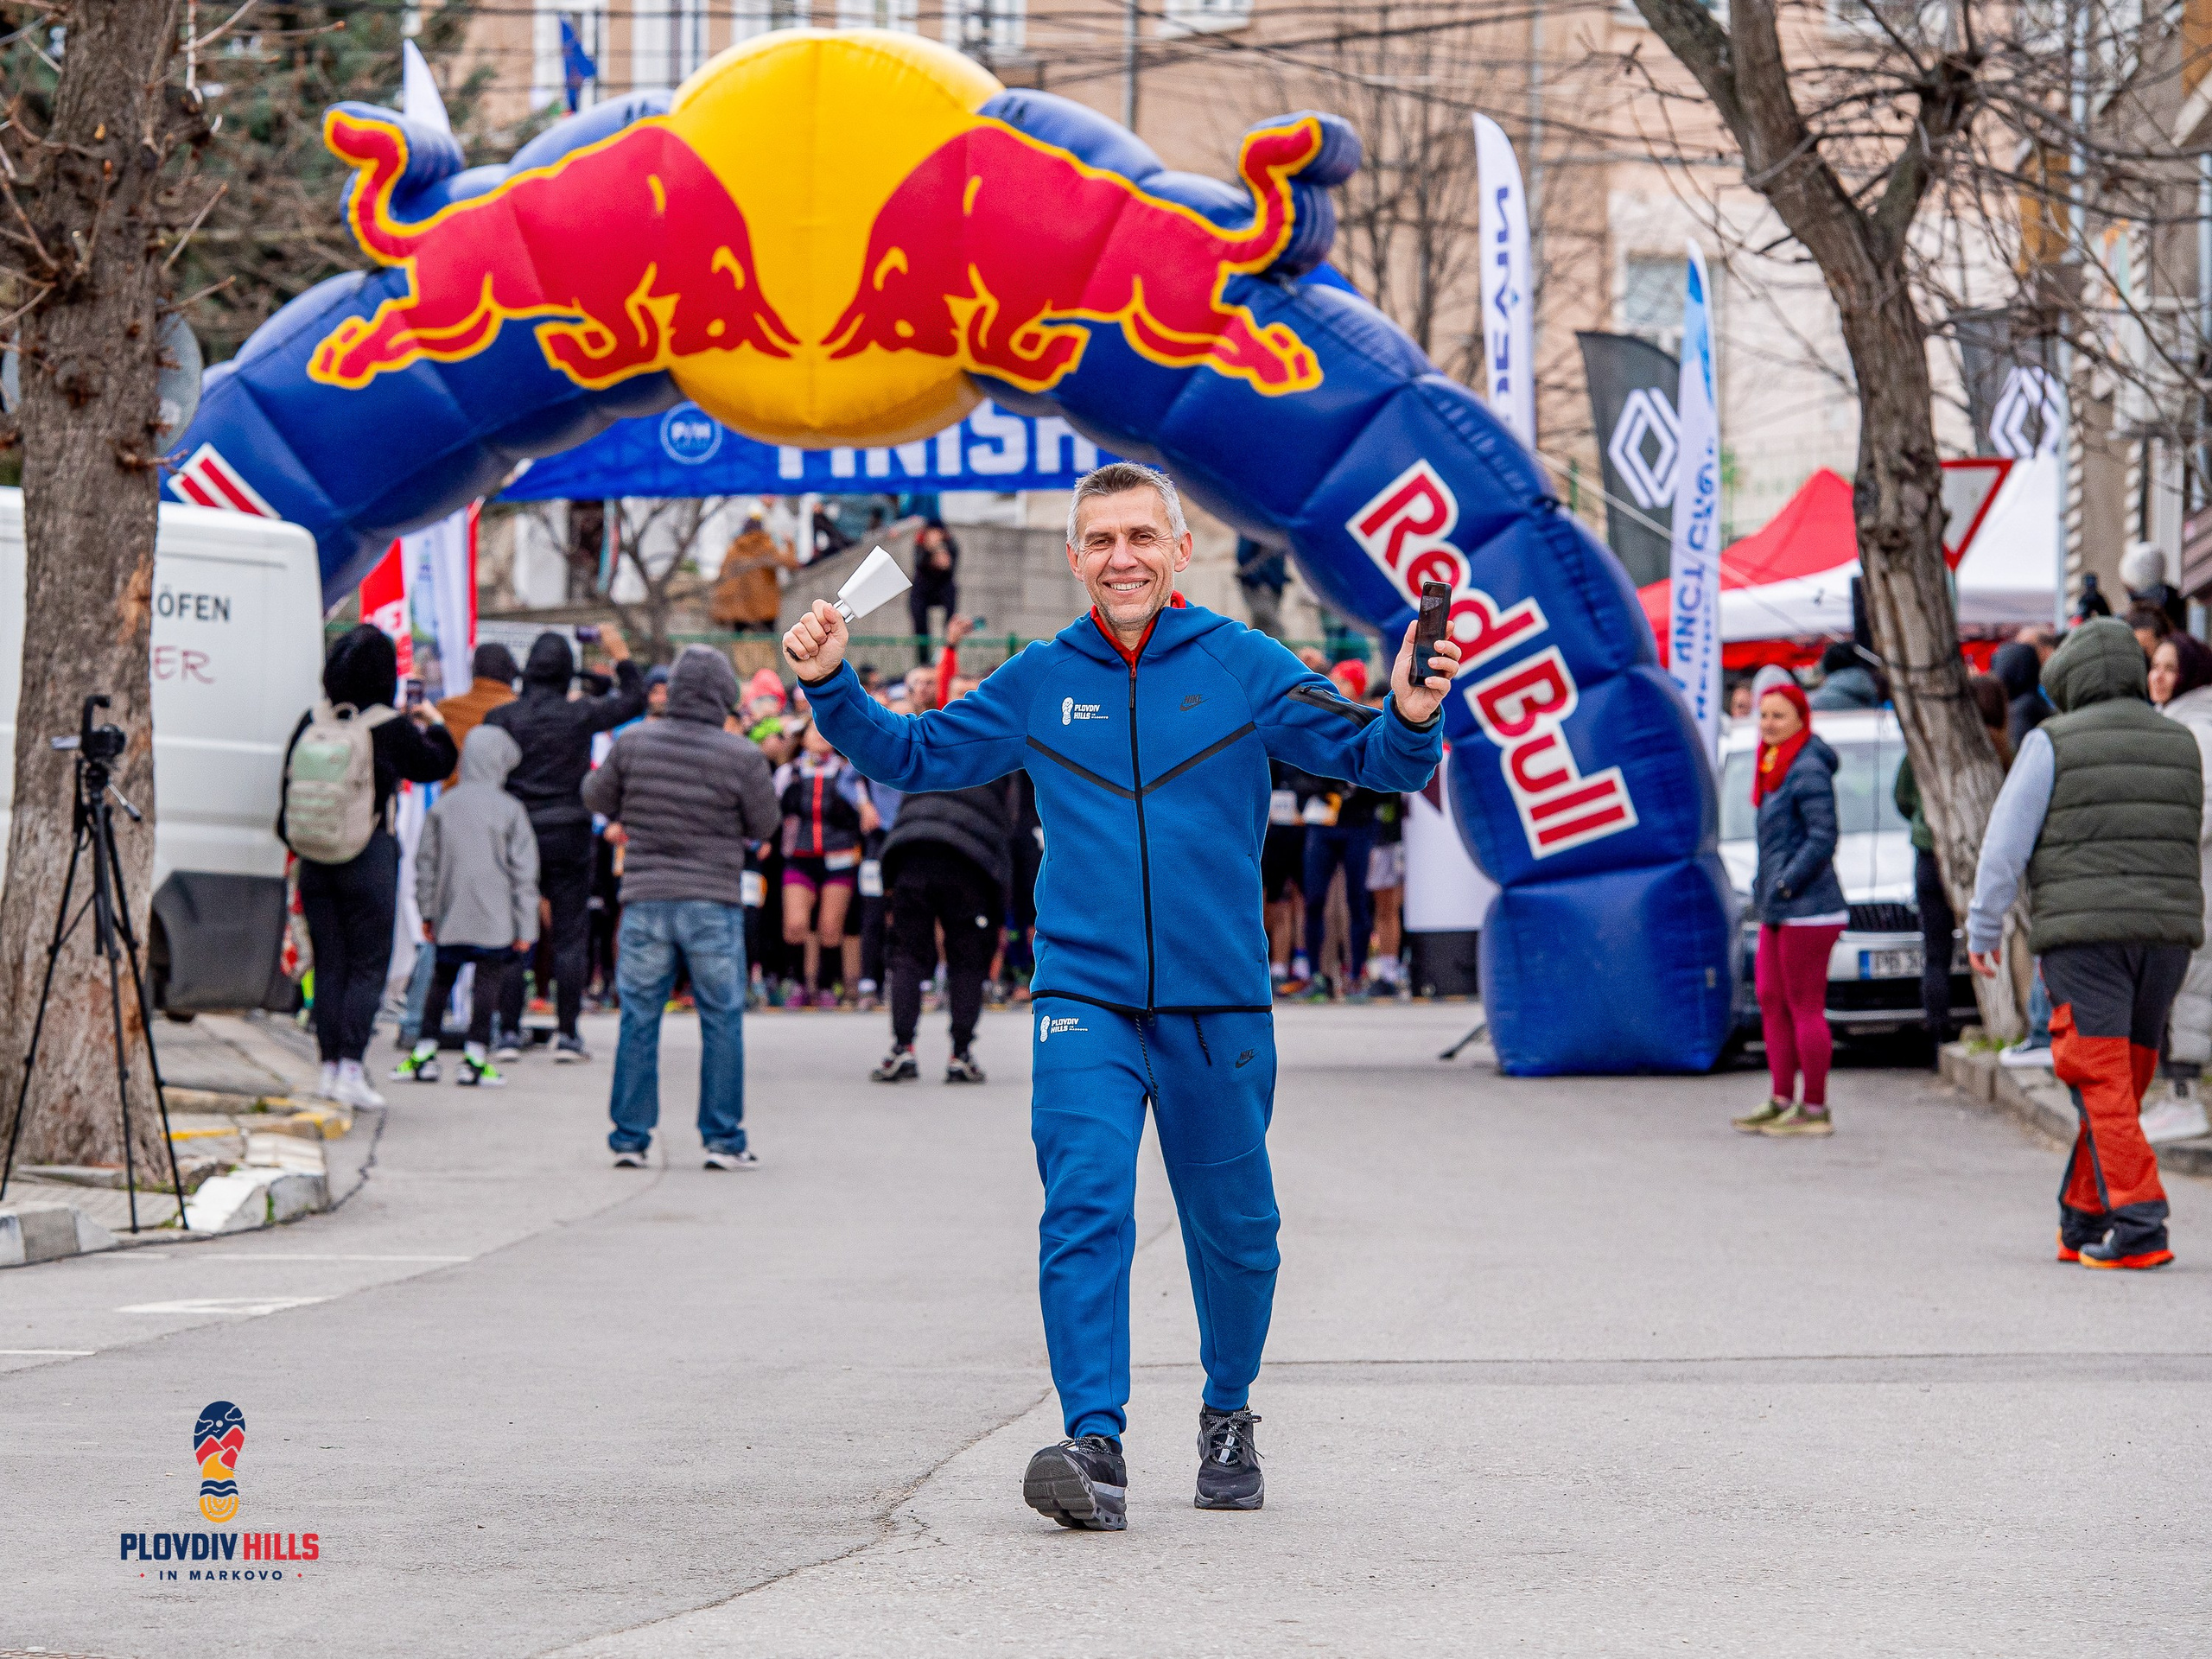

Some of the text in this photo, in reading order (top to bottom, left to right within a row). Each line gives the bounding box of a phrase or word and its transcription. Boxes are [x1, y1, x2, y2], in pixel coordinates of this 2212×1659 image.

[1354, 467, 1628, 849] Red Bull
[1074, 703, 1101, 713] PLOVDIV
[1051, 1018, 1079, 1027] PLOVDIV
[1050, 1025, 1069, 1034] HILLS
